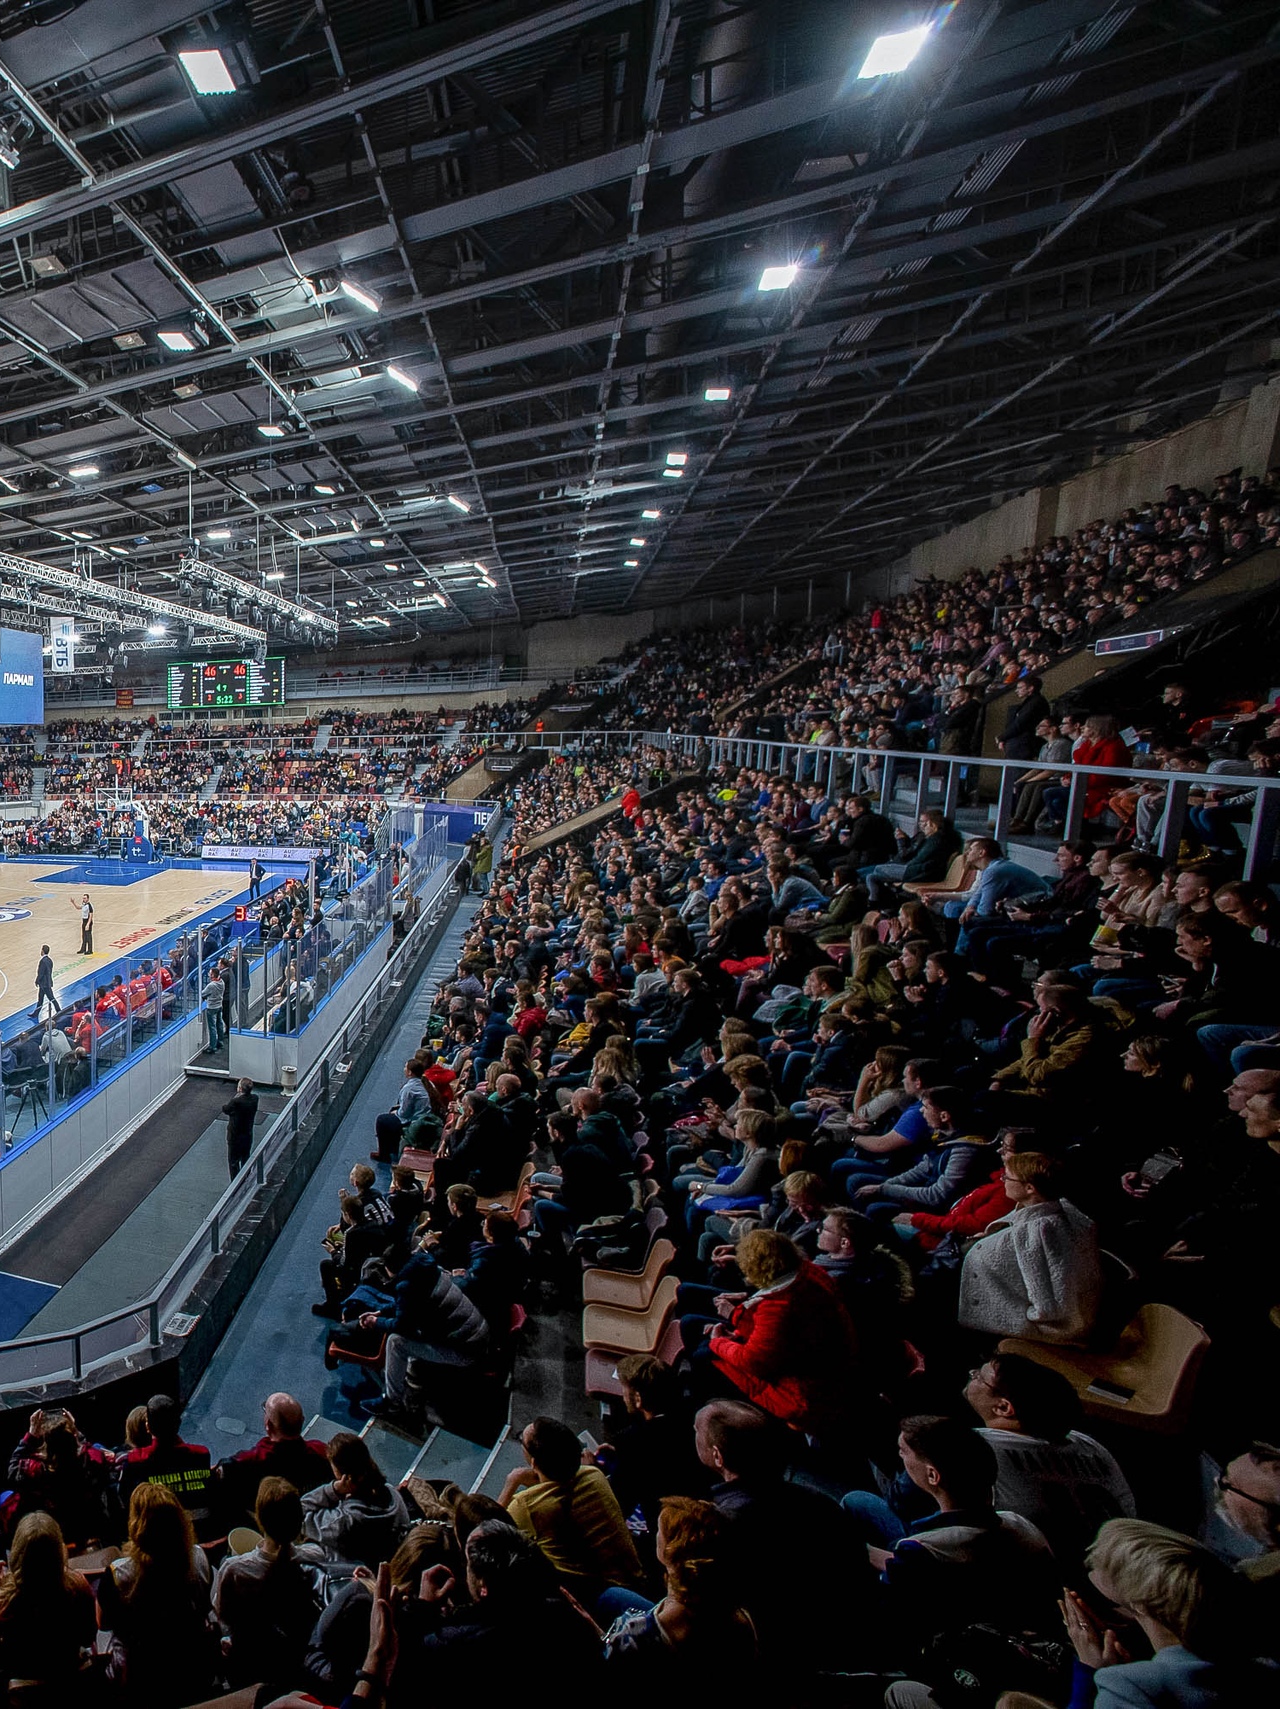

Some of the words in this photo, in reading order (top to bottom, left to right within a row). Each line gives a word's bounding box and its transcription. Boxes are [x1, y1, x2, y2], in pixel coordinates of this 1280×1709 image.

[55, 637, 69, 667] ВТБ
[204, 666, 216, 677] 46
[234, 664, 246, 675] 46
[216, 695, 233, 704] 5:22
[236, 907, 244, 920] 3
